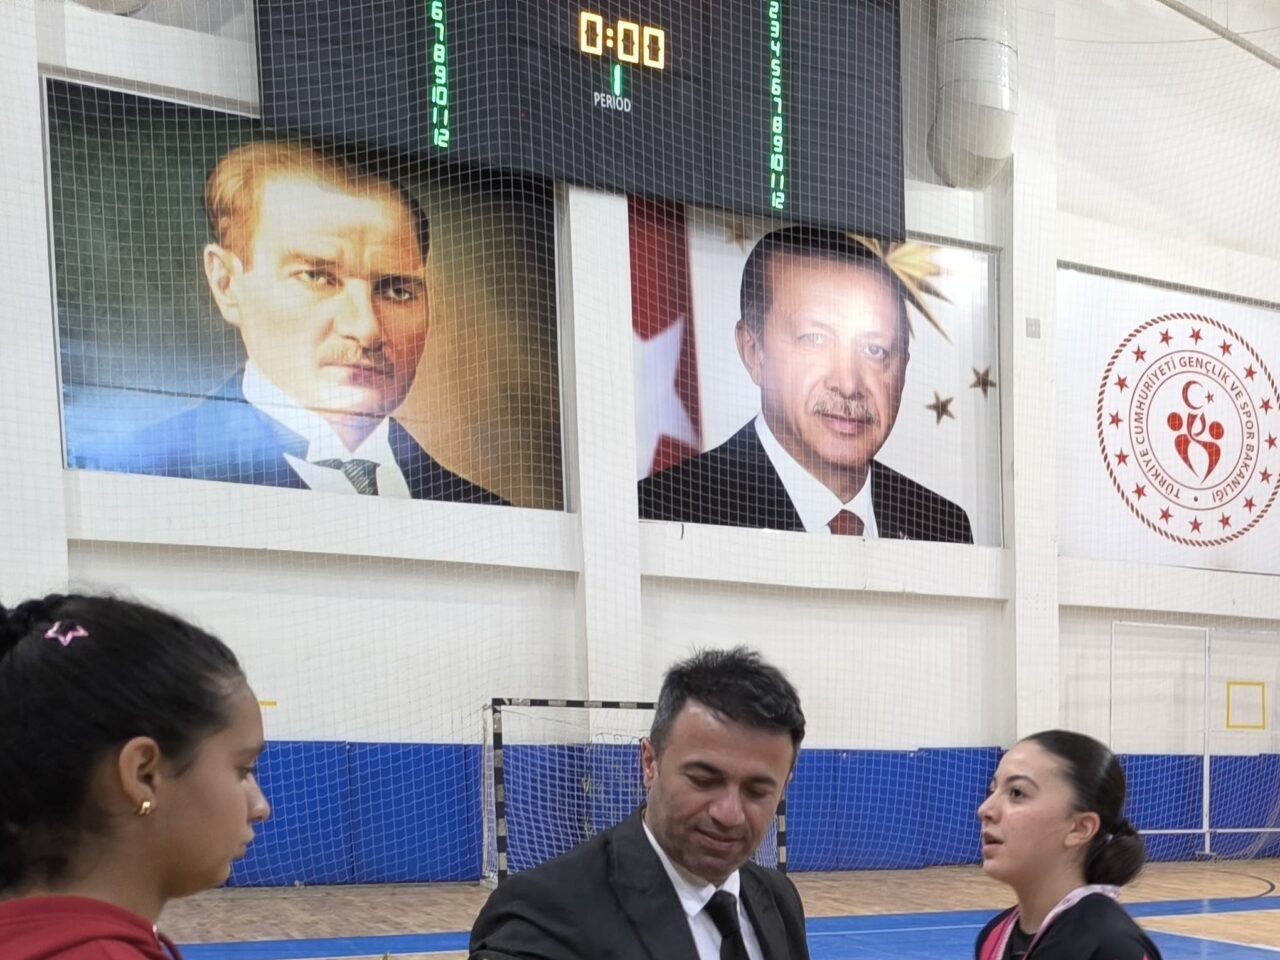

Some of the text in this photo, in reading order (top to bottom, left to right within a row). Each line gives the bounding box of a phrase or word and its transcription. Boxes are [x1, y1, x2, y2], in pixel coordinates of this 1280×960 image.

[431, 1, 443, 21] 6
[768, 1, 779, 19] 2
[434, 22, 444, 42] 7
[770, 20, 780, 38] 3
[580, 11, 665, 70] 0:00
[770, 40, 780, 57] 4
[433, 43, 445, 63] 8
[435, 64, 446, 84] 9
[771, 58, 780, 76] 5
[613, 64, 621, 96] 1
[771, 77, 781, 95] 6
[432, 86, 447, 105] 10
[593, 91, 632, 113] PERIOD
[773, 97, 782, 114] 7
[433, 107, 449, 126] 11
[772, 116, 782, 133] 8
[434, 128, 450, 147] 12
[773, 135, 783, 153] 9
[770, 154, 784, 171] 10
[771, 172, 785, 190] 11
[771, 192, 785, 208] 12
[1133, 356, 1255, 501] TÜRKİYE CUMHURİYETİ GENÇLİK VE SPOR BAKANLIĞI
